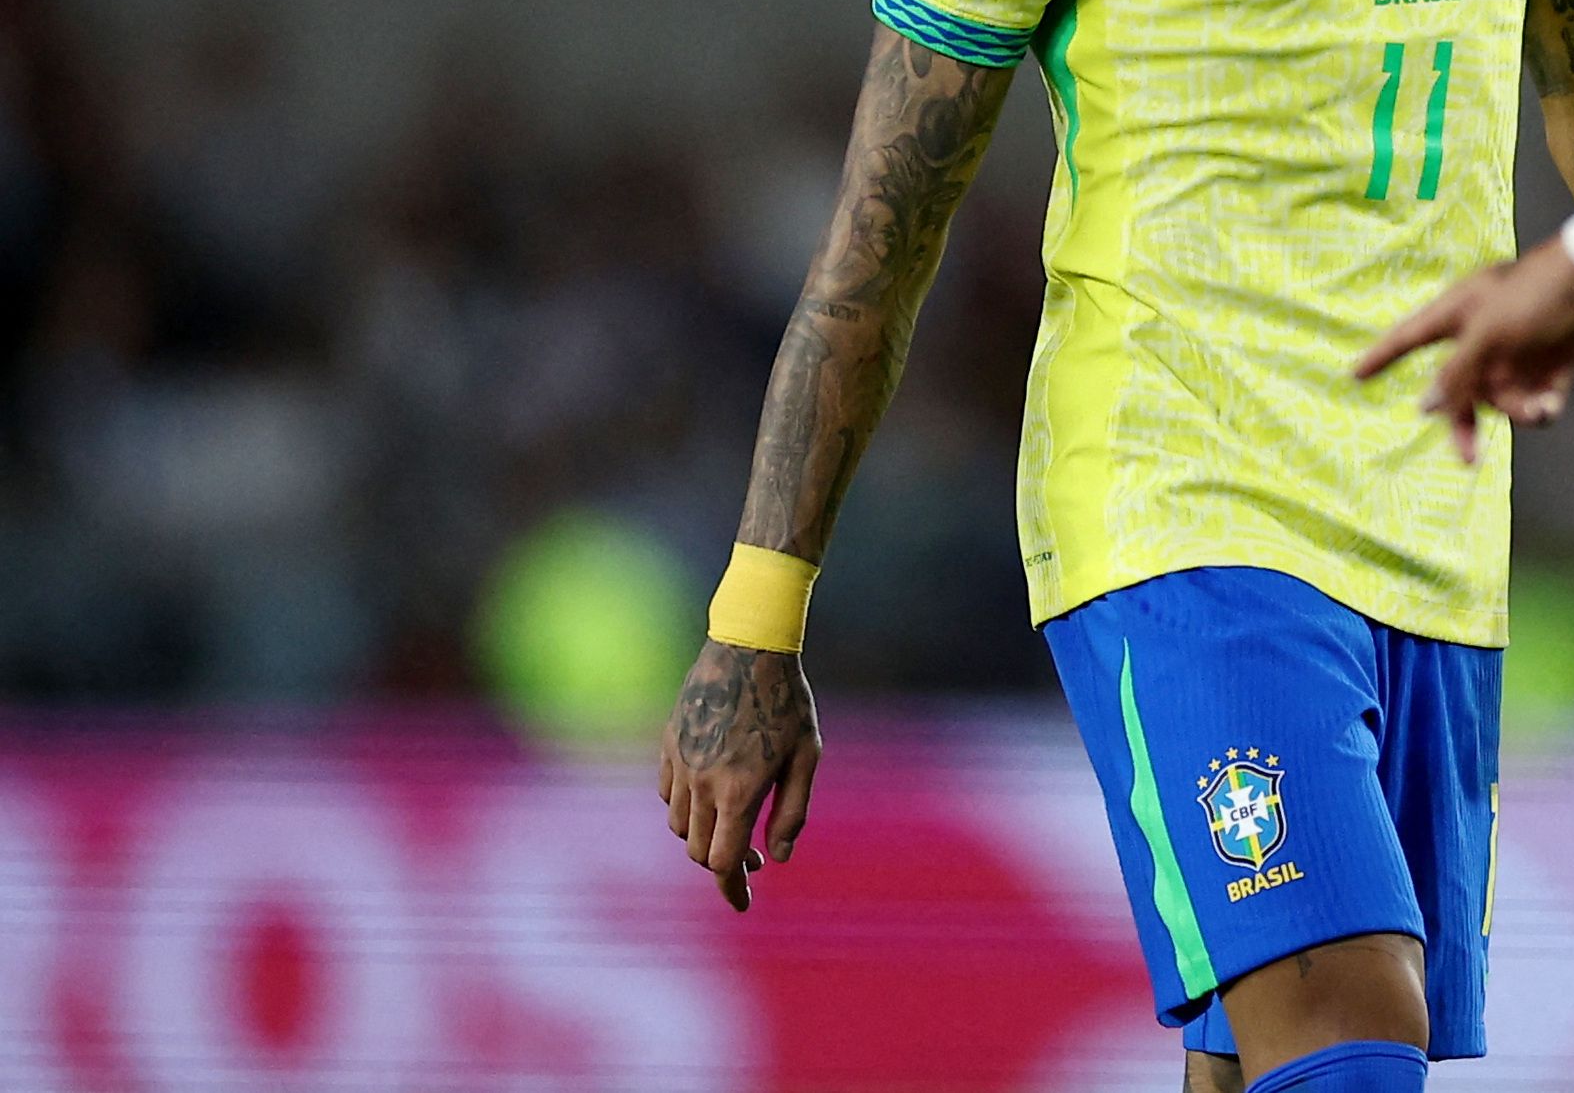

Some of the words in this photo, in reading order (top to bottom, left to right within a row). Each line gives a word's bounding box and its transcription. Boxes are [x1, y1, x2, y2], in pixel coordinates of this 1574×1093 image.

[1364, 41, 1454, 201] 11
[1230, 802, 1259, 823] CBF
[1226, 861, 1305, 903] BRASIL
